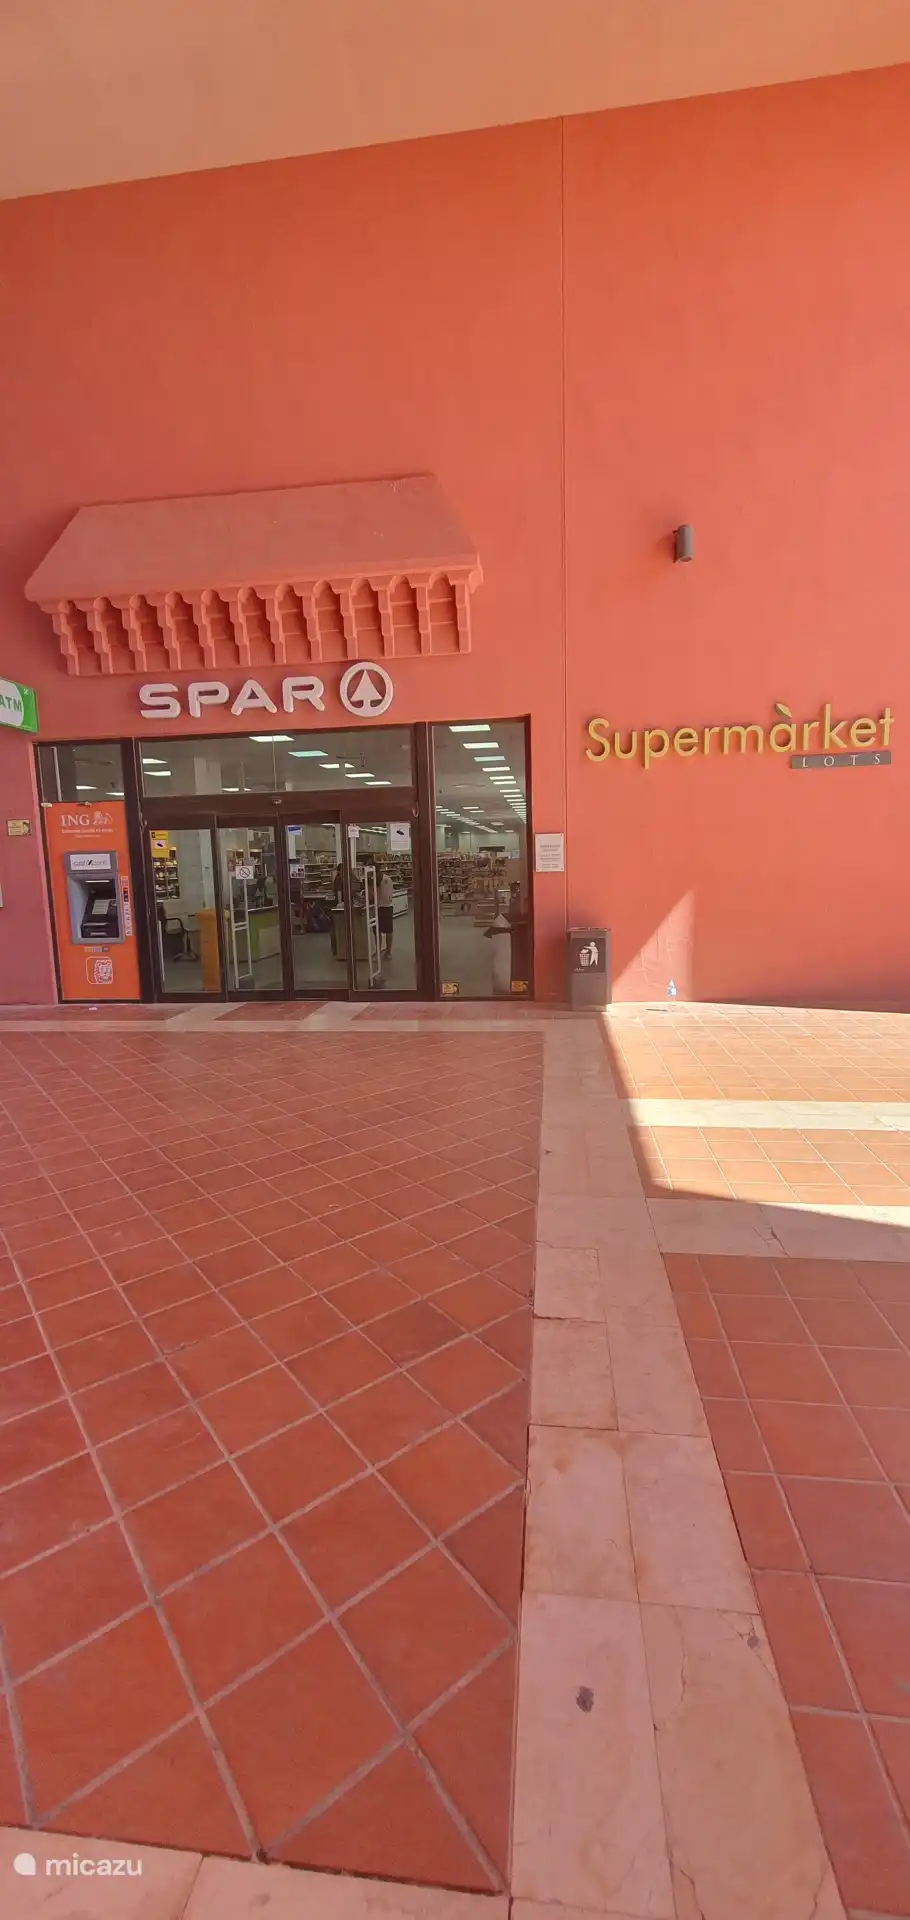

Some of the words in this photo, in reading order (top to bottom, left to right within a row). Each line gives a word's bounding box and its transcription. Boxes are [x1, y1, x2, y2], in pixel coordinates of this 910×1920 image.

[139, 676, 325, 718] SPAR
[802, 753, 881, 767] LOTS
[60, 814, 90, 826] ING
